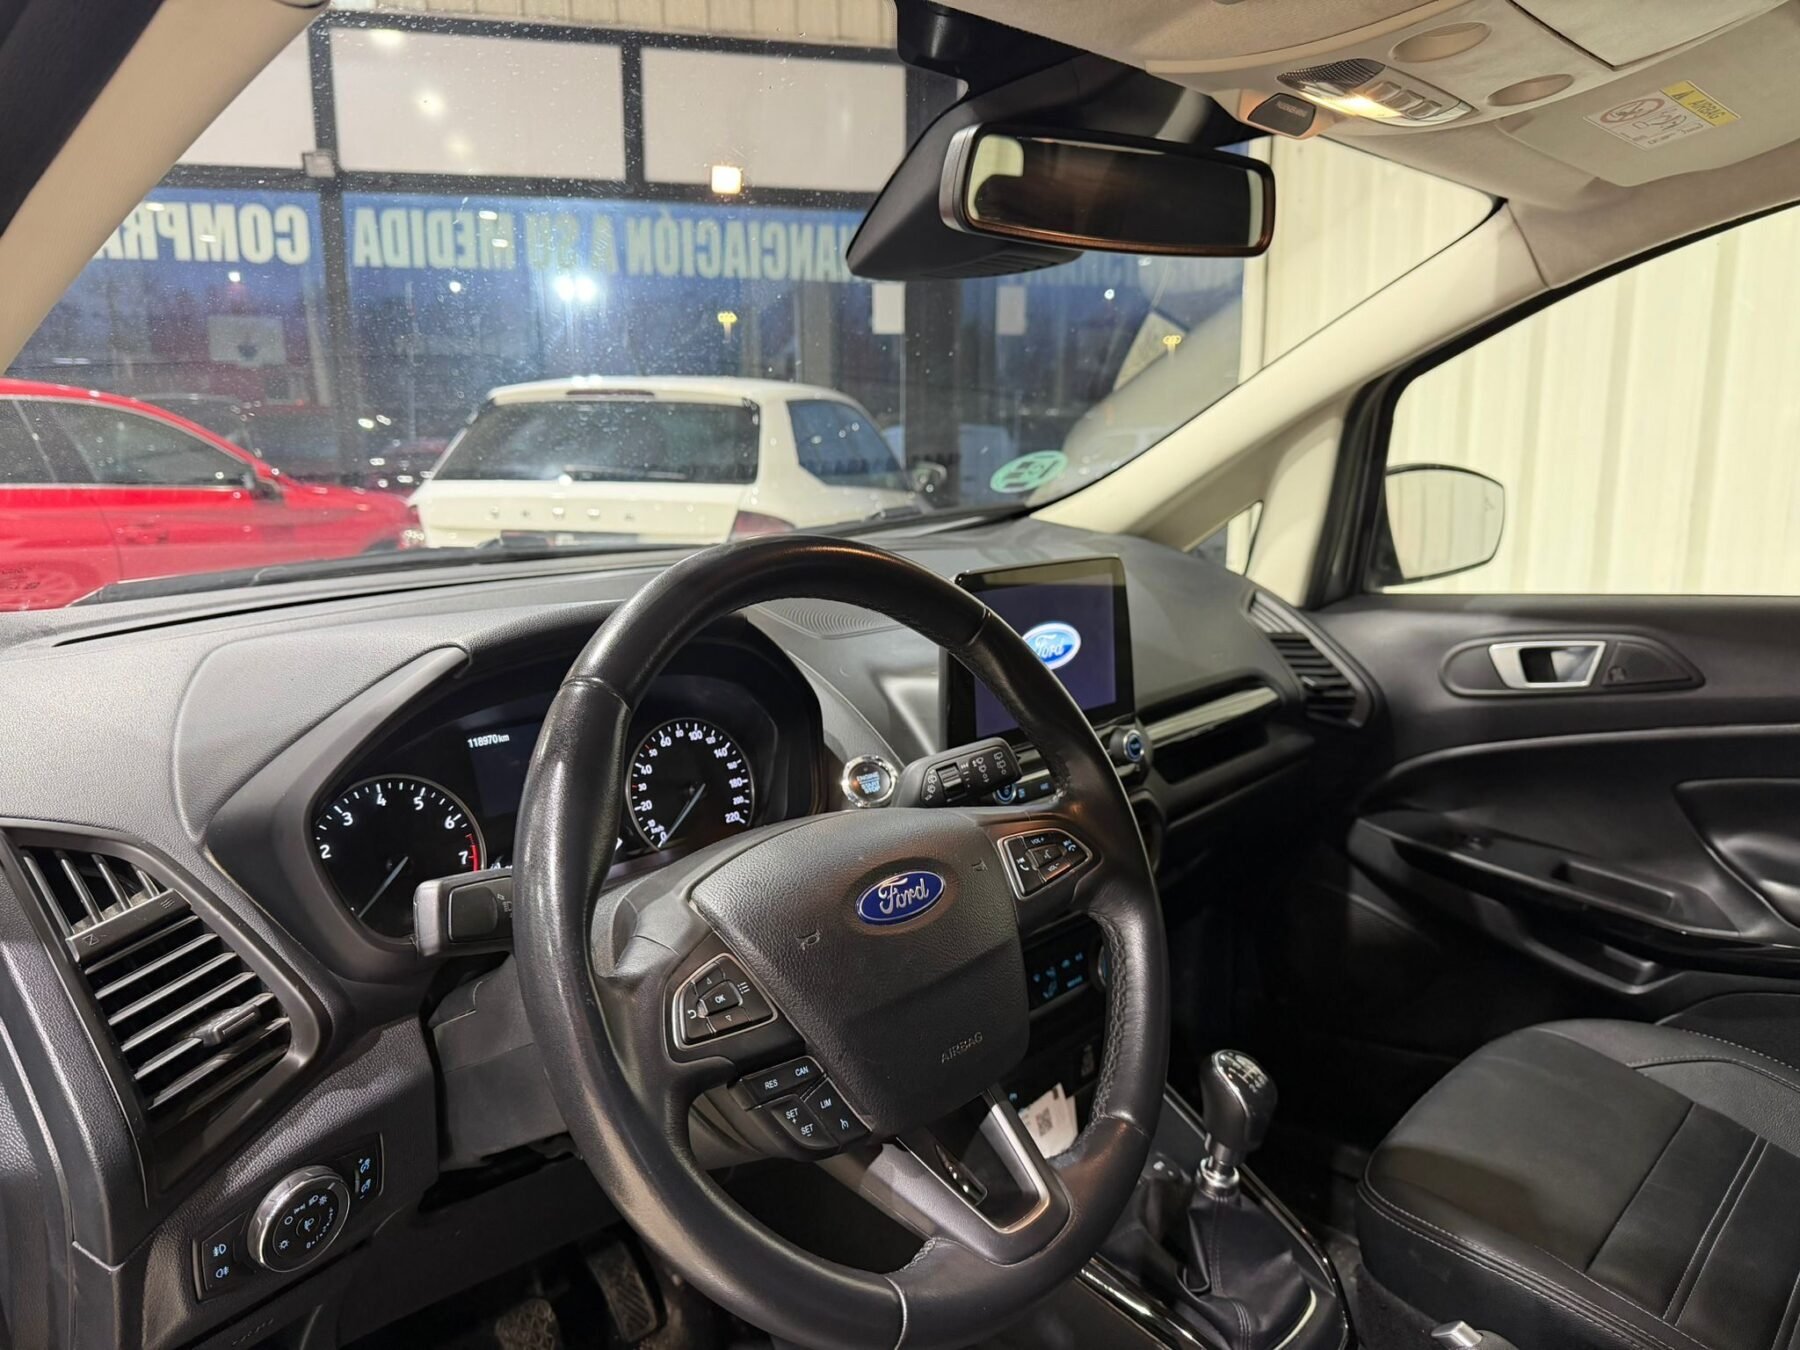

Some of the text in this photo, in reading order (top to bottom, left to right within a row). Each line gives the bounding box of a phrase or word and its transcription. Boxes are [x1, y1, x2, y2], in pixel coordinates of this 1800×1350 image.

[1035, 634, 1065, 659] Ford
[688, 730, 703, 741] 100
[660, 736, 672, 748] 60
[714, 748, 728, 758] 140
[640, 764, 653, 775] 40
[376, 794, 387, 807] 4
[413, 796, 424, 811] 5
[640, 800, 652, 812] 20
[342, 812, 353, 826] 3
[445, 816, 455, 830] 6
[725, 811, 740, 823] 220
[319, 845, 332, 860] 2
[458, 851, 468, 864] 7
[878, 877, 930, 915] Ford
[714, 994, 726, 1004] OK
[795, 1066, 809, 1076] CAN
[764, 1079, 778, 1090] RES
[820, 1098, 832, 1110] LIM
[786, 1108, 799, 1120] SET
[801, 1123, 814, 1134] SET
